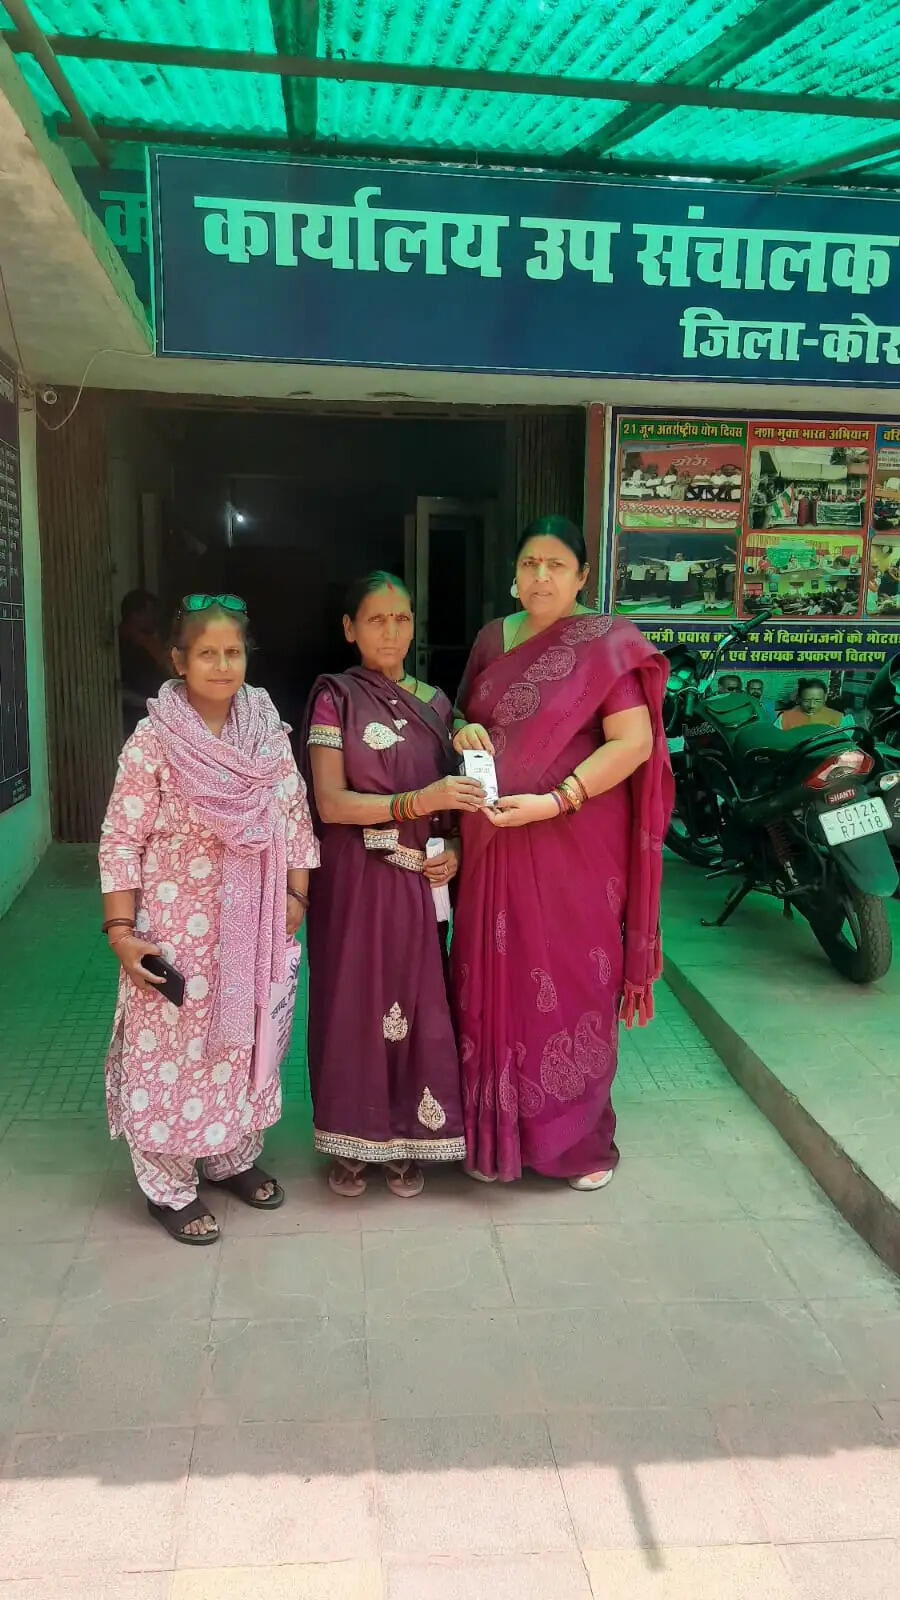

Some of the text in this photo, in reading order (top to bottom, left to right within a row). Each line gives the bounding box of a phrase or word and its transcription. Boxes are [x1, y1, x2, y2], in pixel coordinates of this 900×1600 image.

[193, 186, 900, 295] कार्यालय उप संचालक
[623, 423, 636, 435] 21
[639, 423, 655, 438] जून
[701, 422, 717, 436] योग
[720, 423, 743, 437] दिवस
[754, 427, 870, 442] नशा मुक्त भारत अभियान
[677, 631, 711, 645] प्रवास
[763, 629, 775, 643] में
[777, 629, 845, 644] दिव्यांगजनों
[847, 630, 863, 644] को
[866, 630, 900, 644] मोटरा
[750, 650, 795, 662] सहायक
[797, 651, 843, 662] उपकरण
[845, 648, 887, 662] वितरण
[836, 802, 877, 824] CG12A
[841, 816, 883, 839] R7118
